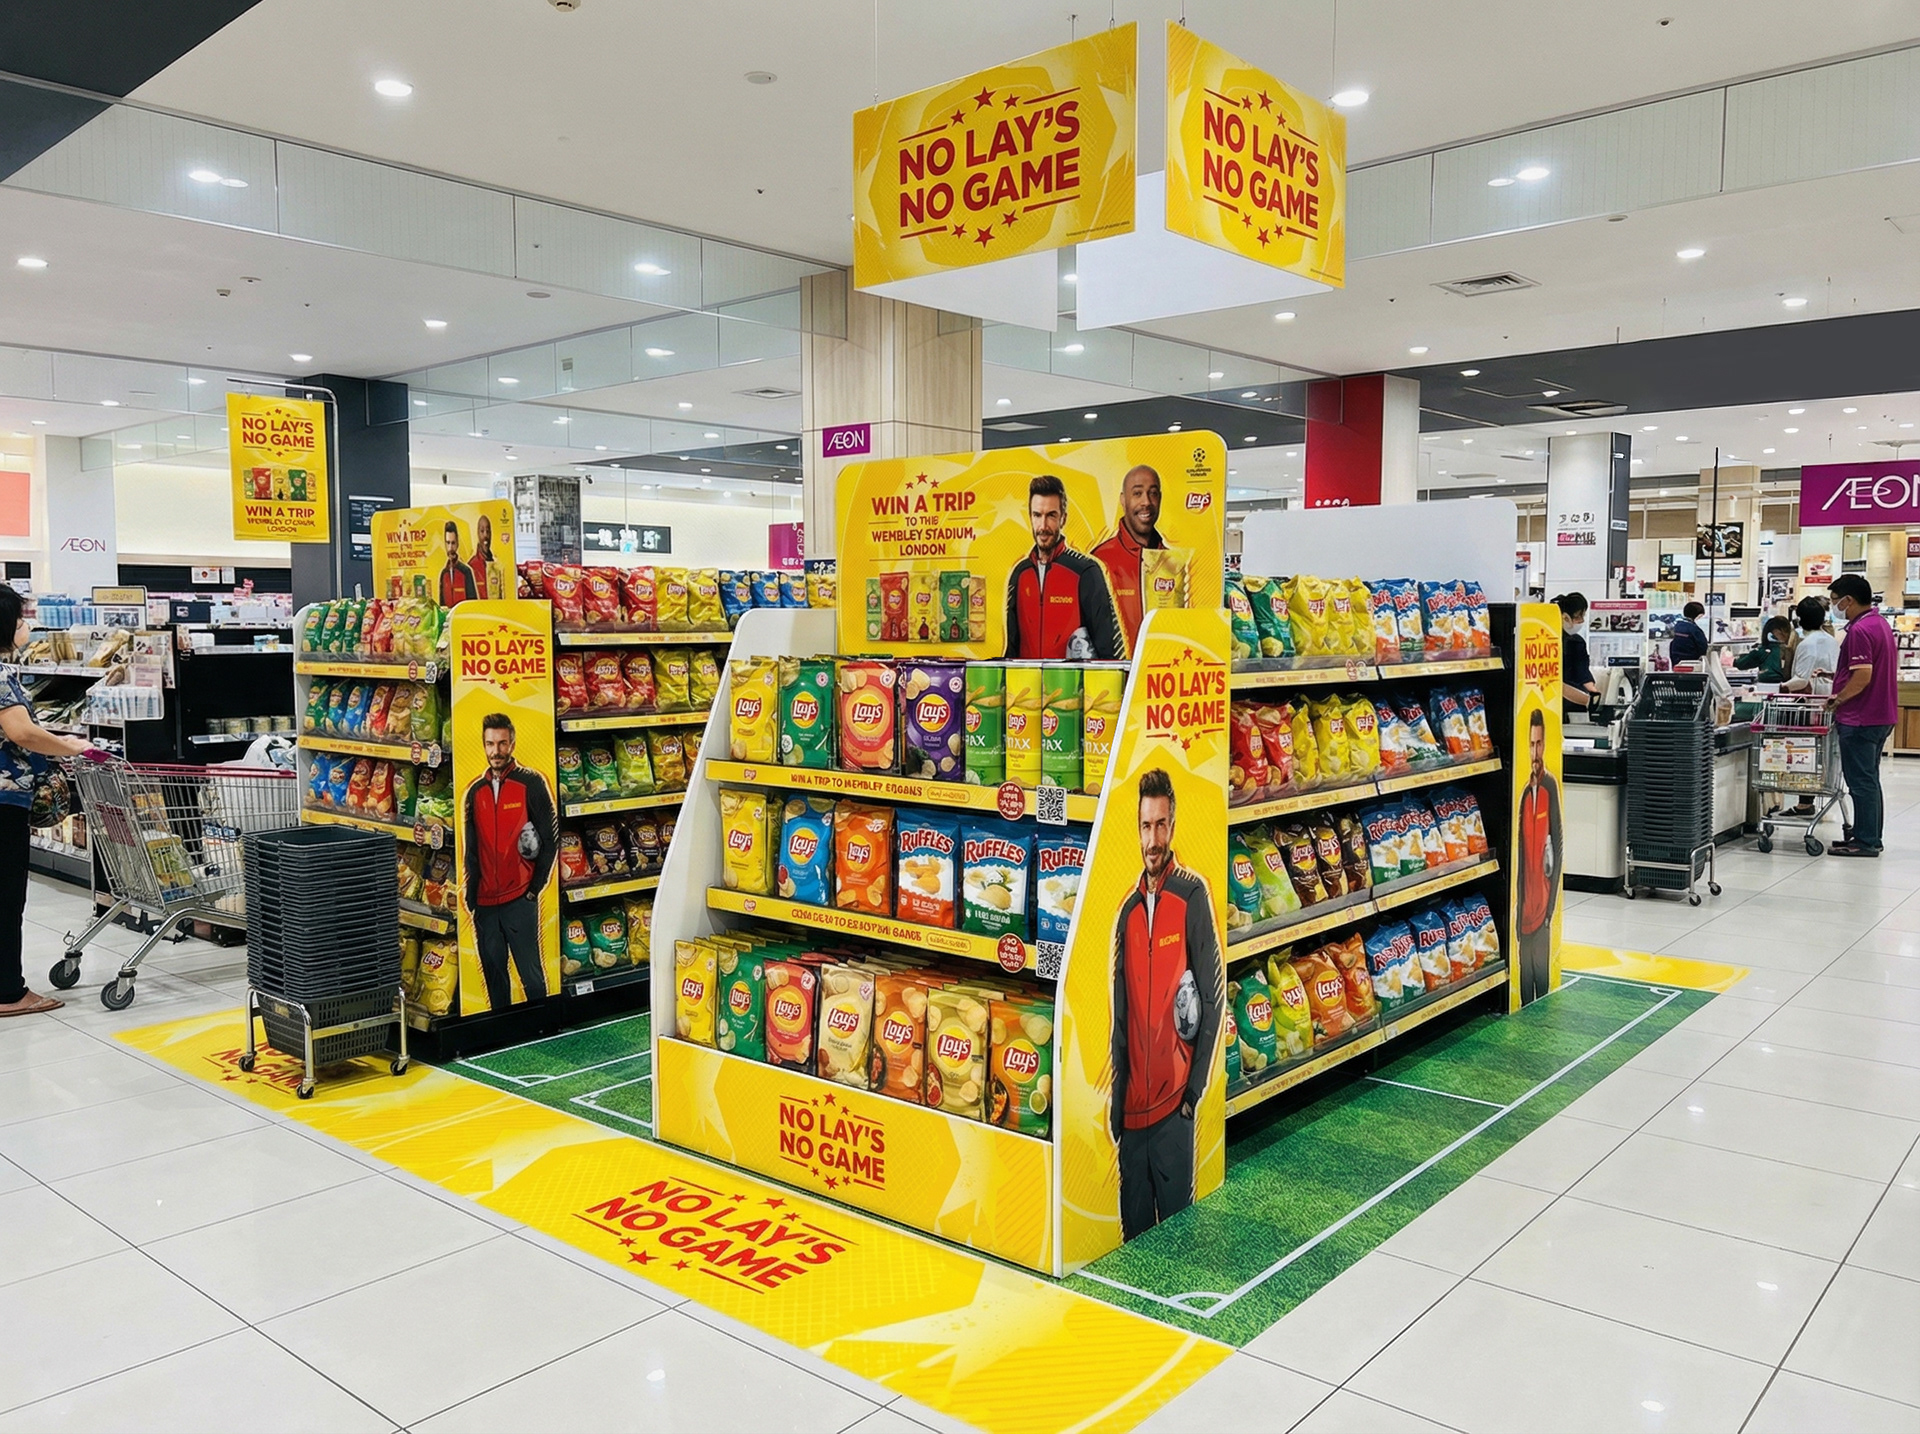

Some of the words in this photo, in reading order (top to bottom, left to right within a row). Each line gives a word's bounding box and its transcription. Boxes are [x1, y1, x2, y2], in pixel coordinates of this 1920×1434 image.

[900, 138, 955, 184] NO
[966, 101, 1080, 168] LAY'S
[1204, 101, 1246, 153] NO
[1253, 125, 1319, 188] LAY'S
[900, 183, 955, 227] NO
[963, 148, 1080, 211] GAME
[1204, 149, 1245, 199] NO
[1249, 171, 1319, 230] GAME
[242, 417, 267, 430] NO
[270, 420, 314, 434] LAY'S
[242, 432, 267, 445] NO
[270, 434, 315, 449] GAME
[245, 505, 271, 517] WIN
[276, 507, 285, 517] A
[287, 508, 315, 518] TRIP
[871, 496, 909, 516] WIN
[914, 495, 928, 513] A
[932, 491, 976, 512] TRIP
[905, 517, 917, 526] TO
[872, 529, 922, 542] WEMBLEY
[925, 527, 976, 541] STADIUM,
[900, 543, 946, 556] LONDON
[461, 640, 491, 656] NO
[495, 639, 545, 656] LAY'S
[1525, 643, 1537, 660] NO
[462, 659, 492, 676] NO
[494, 658, 546, 675] GAME
[1525, 663, 1537, 679] NO
[1538, 662, 1559, 679] GAME
[1147, 672, 1176, 699] NO
[1179, 670, 1226, 697] LAY'S
[1146, 703, 1175, 730] NO
[1177, 700, 1225, 727] GAME
[832, 777, 842, 787] TO
[901, 828, 954, 854] RUFFLES
[964, 839, 1027, 864] RUFFLES
[1039, 846, 1085, 872] RUFFL
[779, 1102, 815, 1132] NO
[820, 1114, 885, 1154] LAY'S
[779, 1129, 814, 1160] NO
[818, 1142, 885, 1184] GAME
[630, 1180, 712, 1213] NO
[700, 1207, 846, 1265] LAY'S
[585, 1197, 668, 1231] NO
[659, 1227, 808, 1289] GAME
